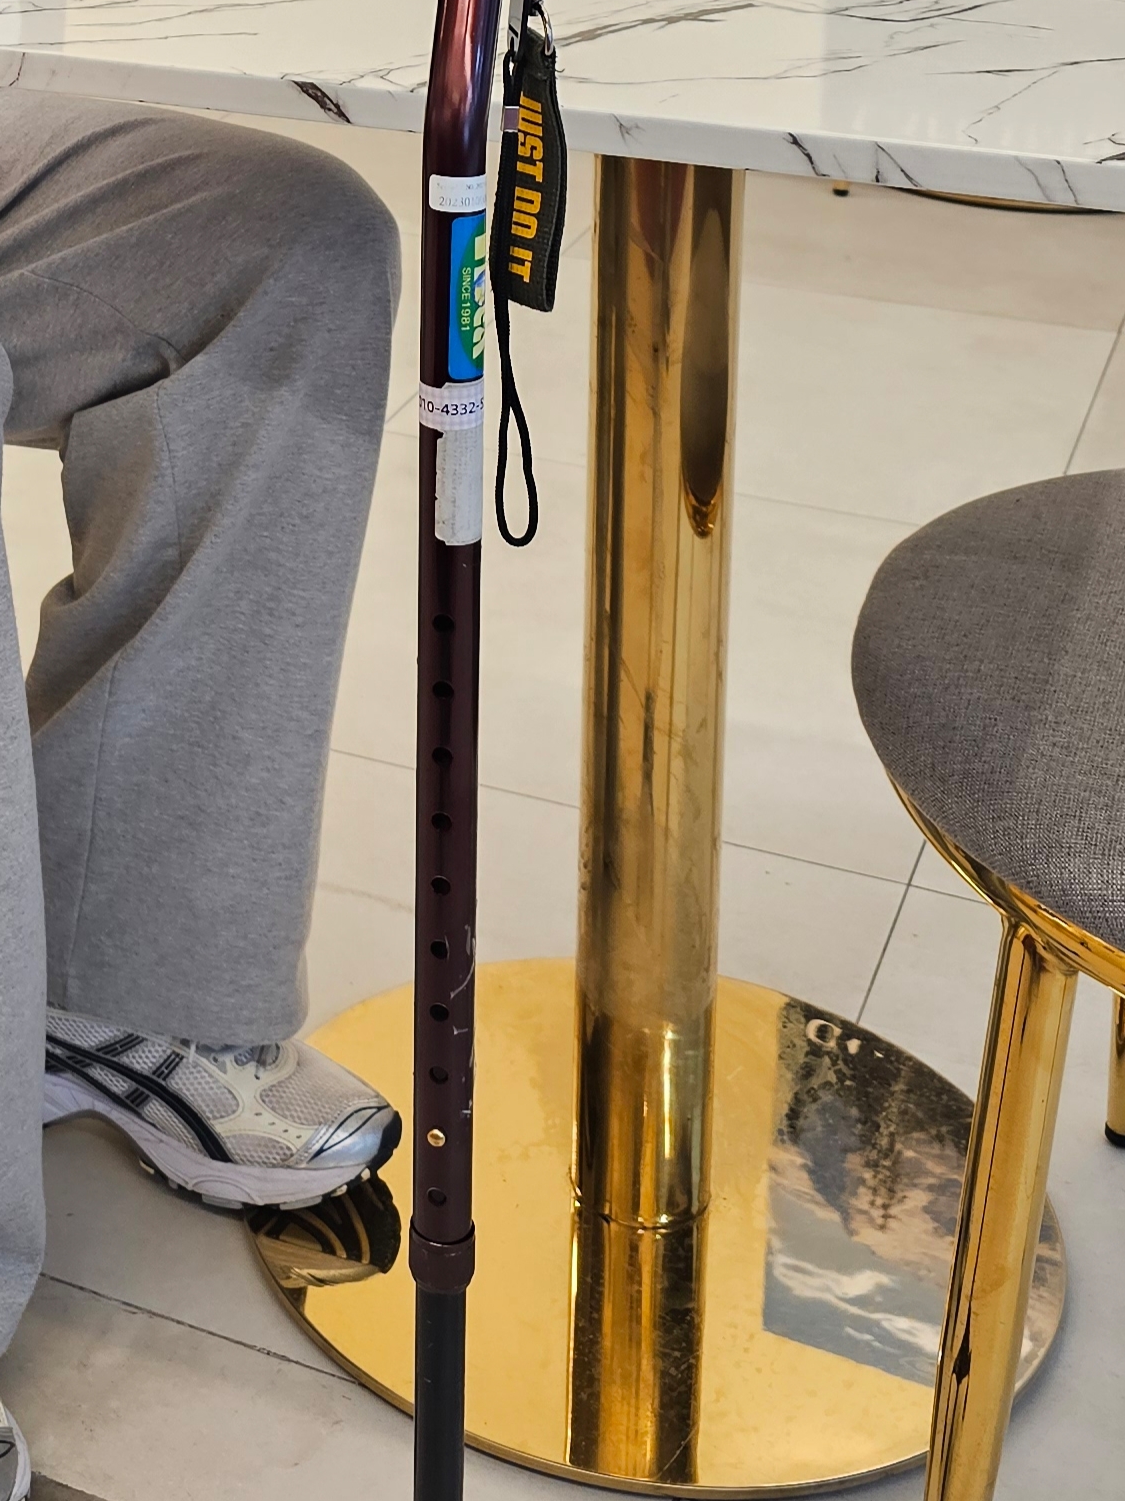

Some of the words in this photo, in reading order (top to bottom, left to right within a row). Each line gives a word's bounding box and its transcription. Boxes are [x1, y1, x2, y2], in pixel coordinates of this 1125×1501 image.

[516, 91, 543, 183] JUST
[511, 186, 542, 239] DO
[508, 245, 533, 283] IT
[461, 267, 472, 300] SINCE
[461, 302, 471, 331] 1981
